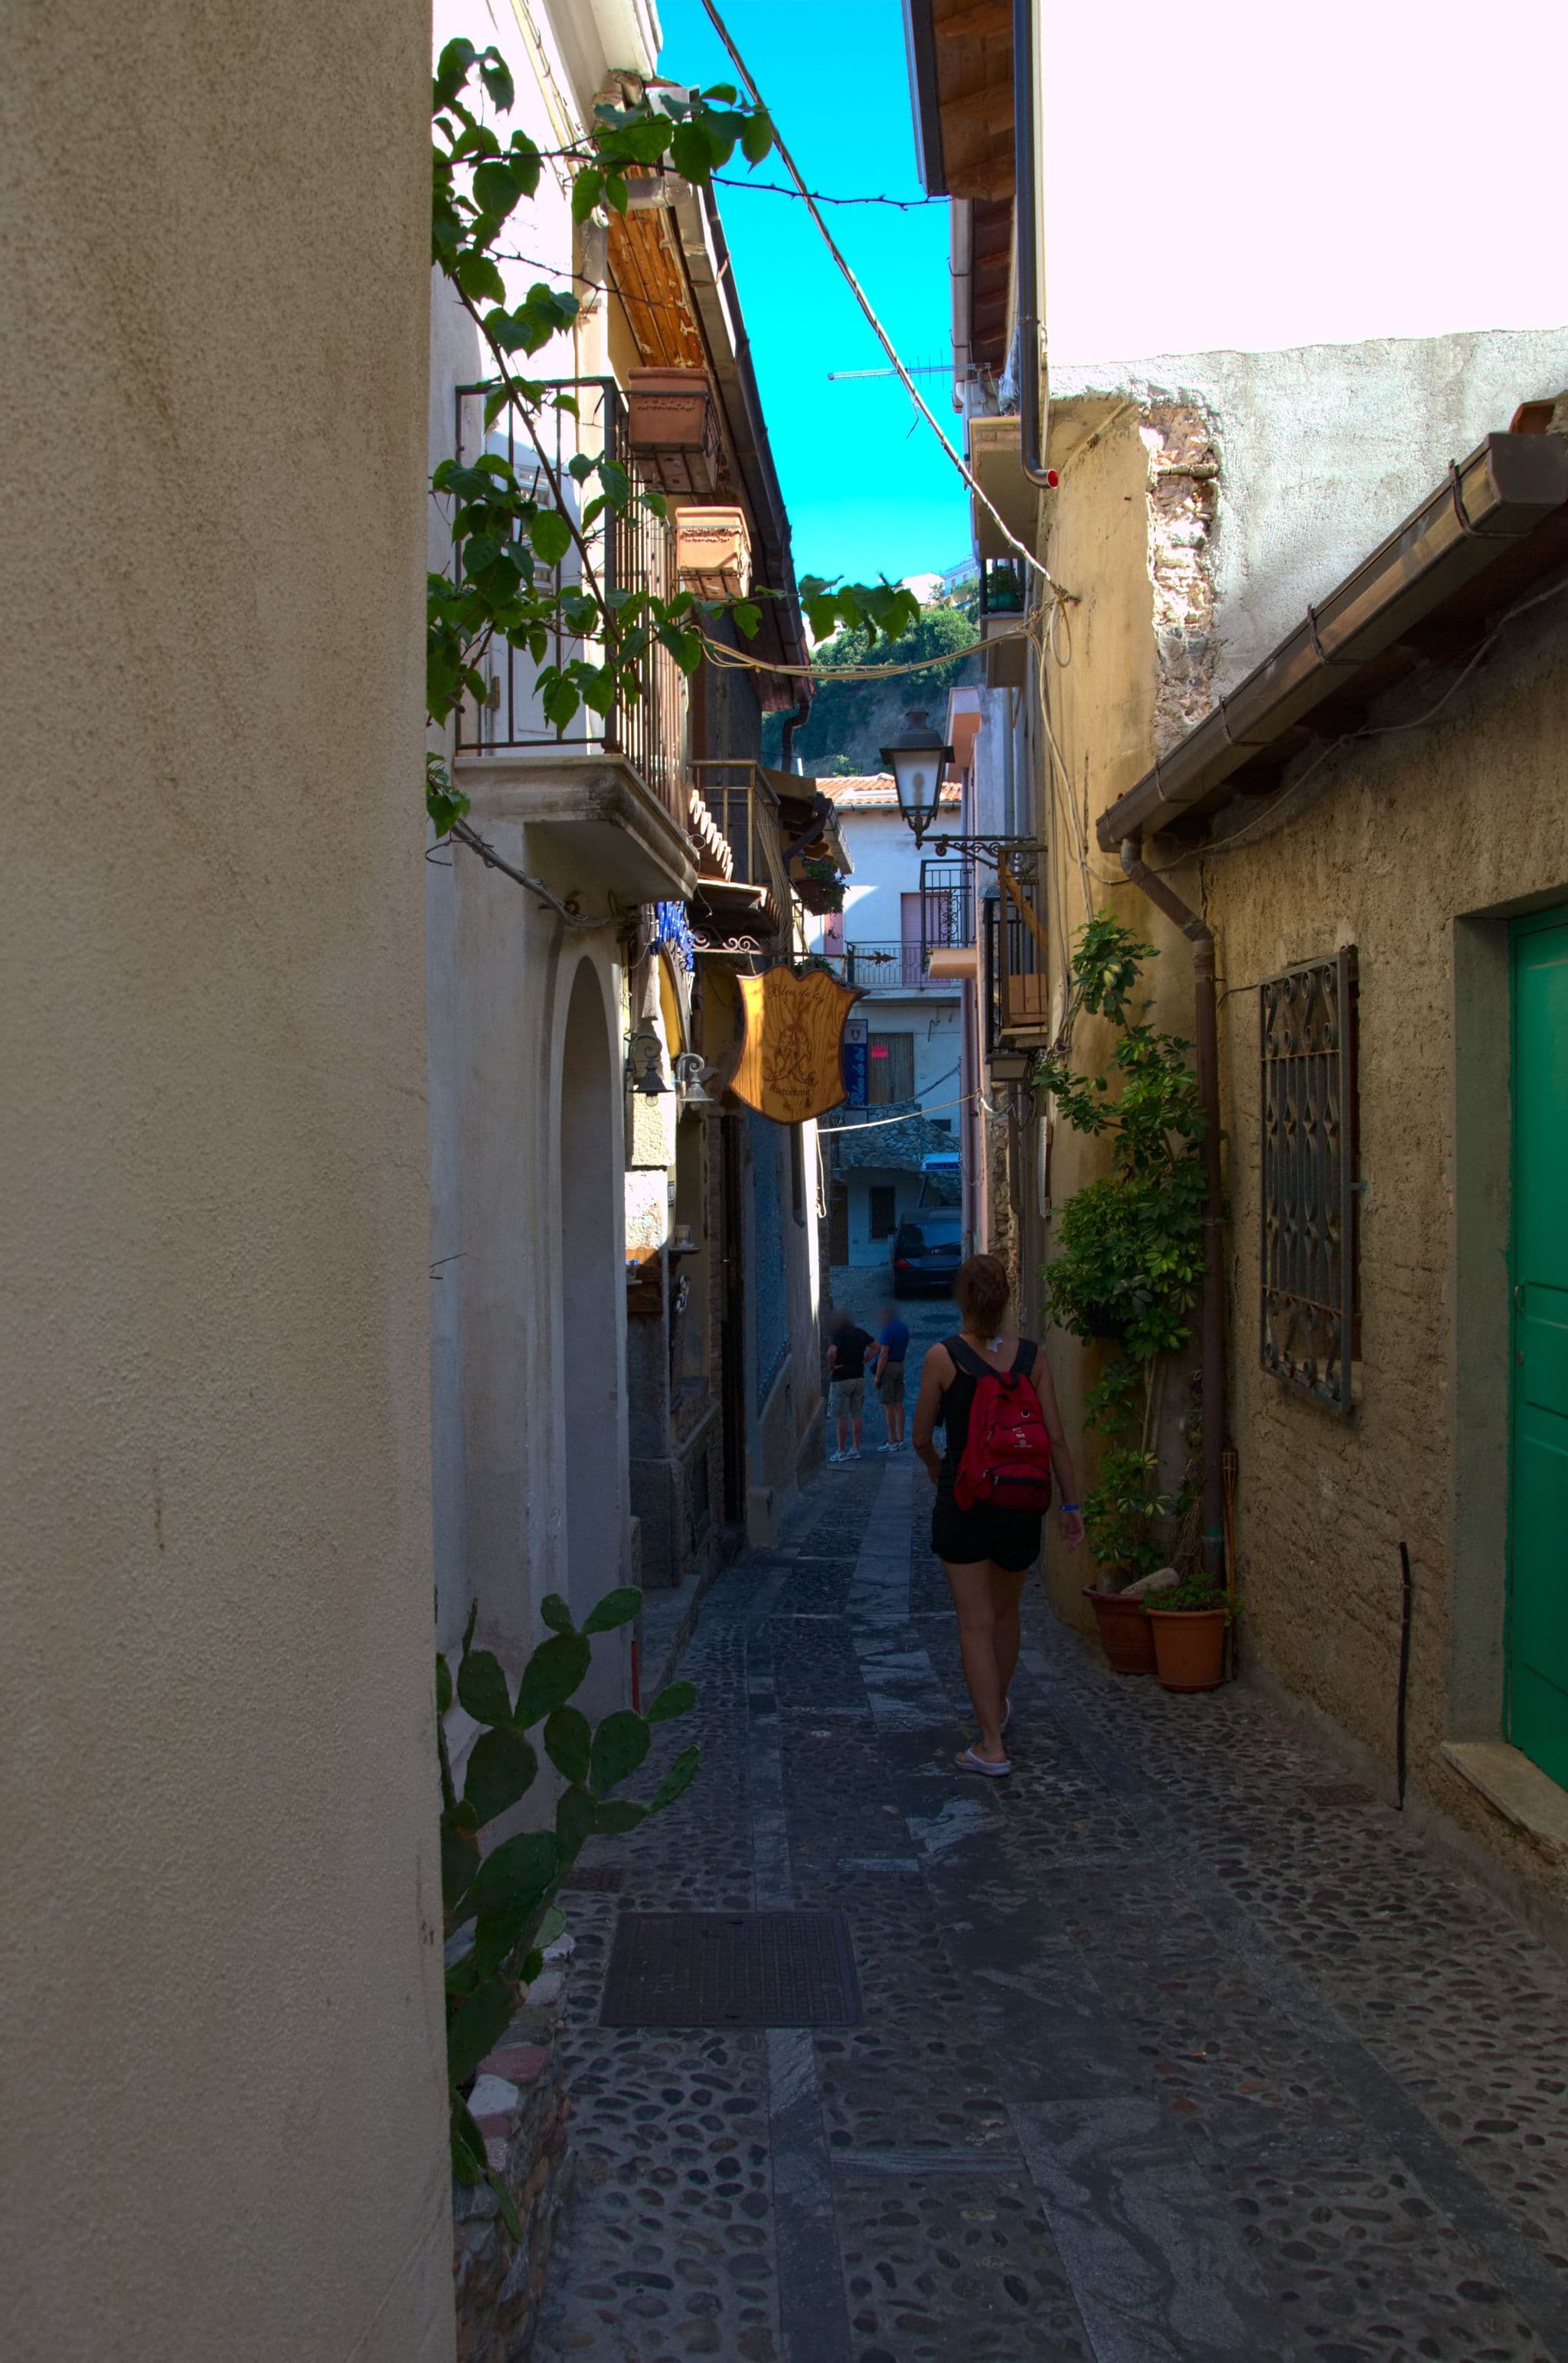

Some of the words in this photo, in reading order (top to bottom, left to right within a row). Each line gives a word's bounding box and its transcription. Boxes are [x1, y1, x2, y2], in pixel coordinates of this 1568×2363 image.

[766, 984, 796, 999] Bleu
[799, 987, 810, 996] de
[769, 1084, 810, 1096] Ristorante
